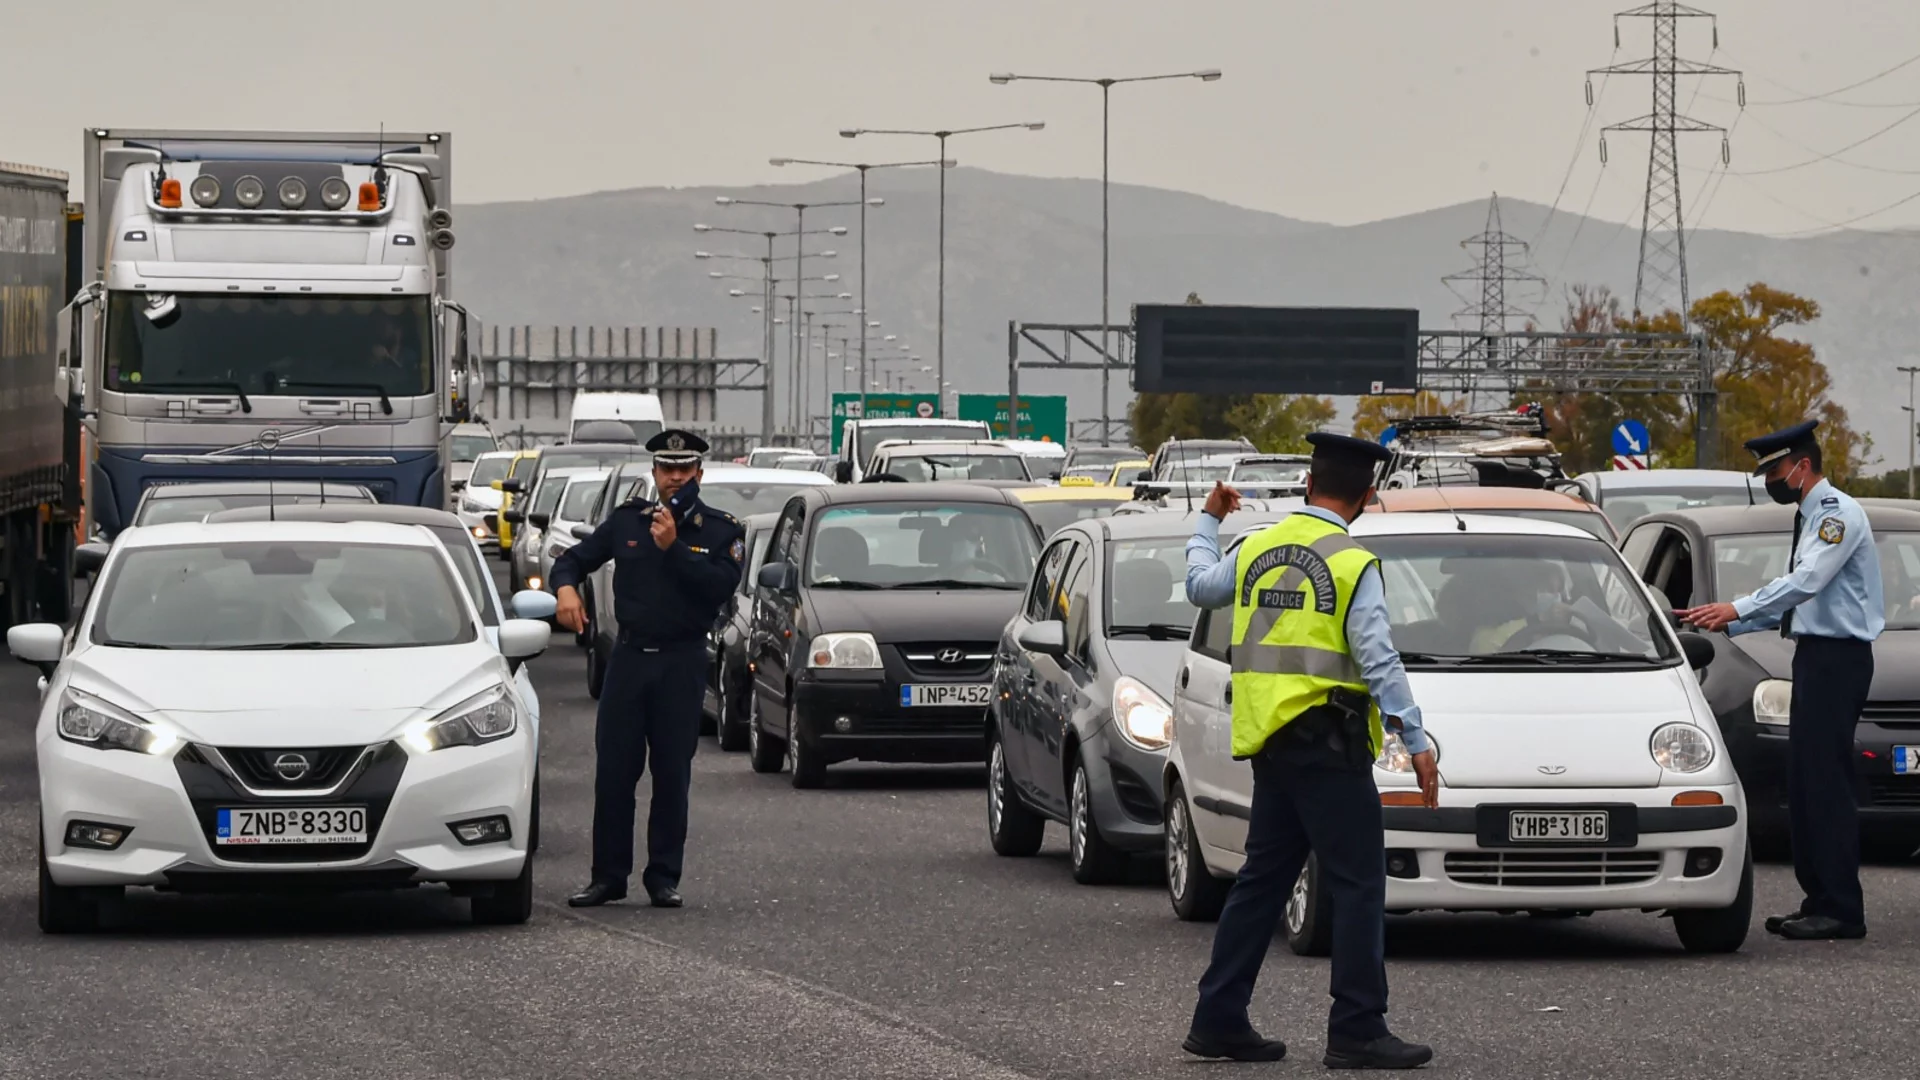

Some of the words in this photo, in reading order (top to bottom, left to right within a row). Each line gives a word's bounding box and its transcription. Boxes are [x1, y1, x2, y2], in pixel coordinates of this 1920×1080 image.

[1264, 591, 1302, 608] POLICE
[919, 686, 992, 703] INP-452
[239, 810, 363, 836] ZNB-8330
[1514, 816, 1604, 837] YHB-3186
